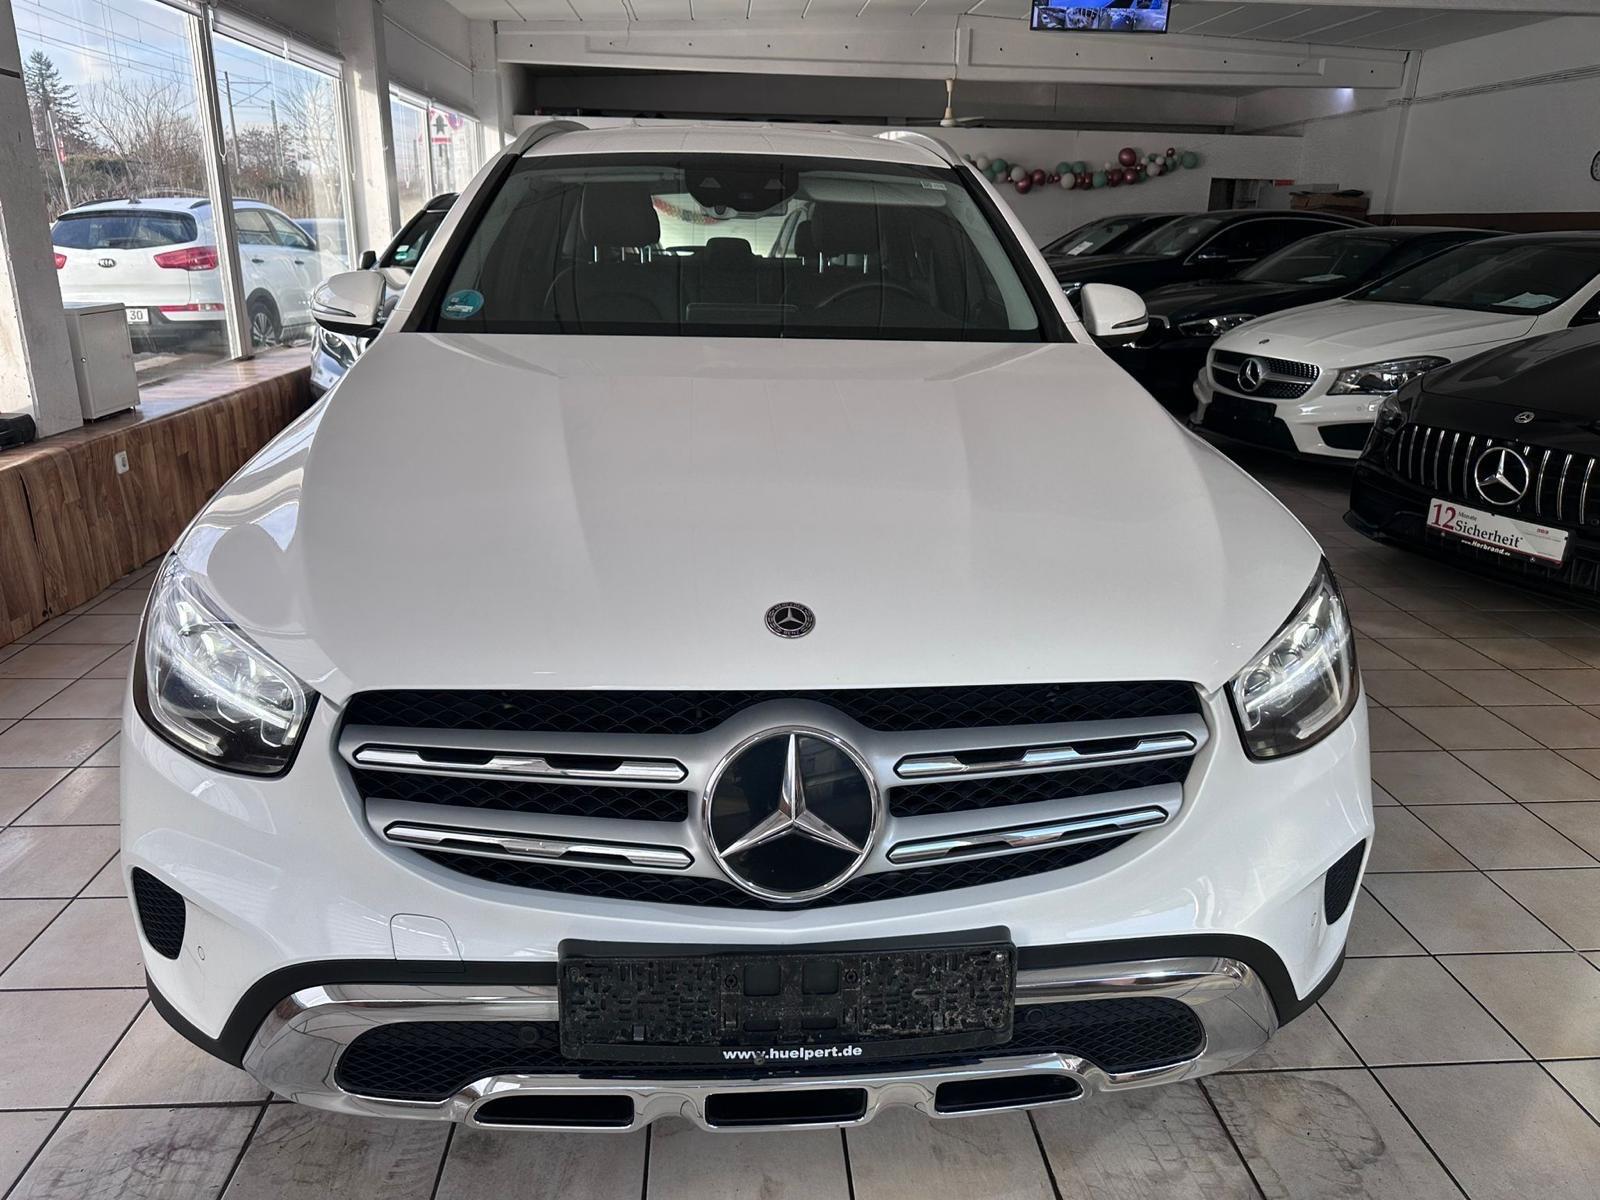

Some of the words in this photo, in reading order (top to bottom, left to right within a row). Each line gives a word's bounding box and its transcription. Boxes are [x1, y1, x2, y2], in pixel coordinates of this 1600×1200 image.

[129, 310, 143, 320] 30
[1431, 503, 1456, 530] 12
[722, 1045, 863, 1060] www.huelpert.de
